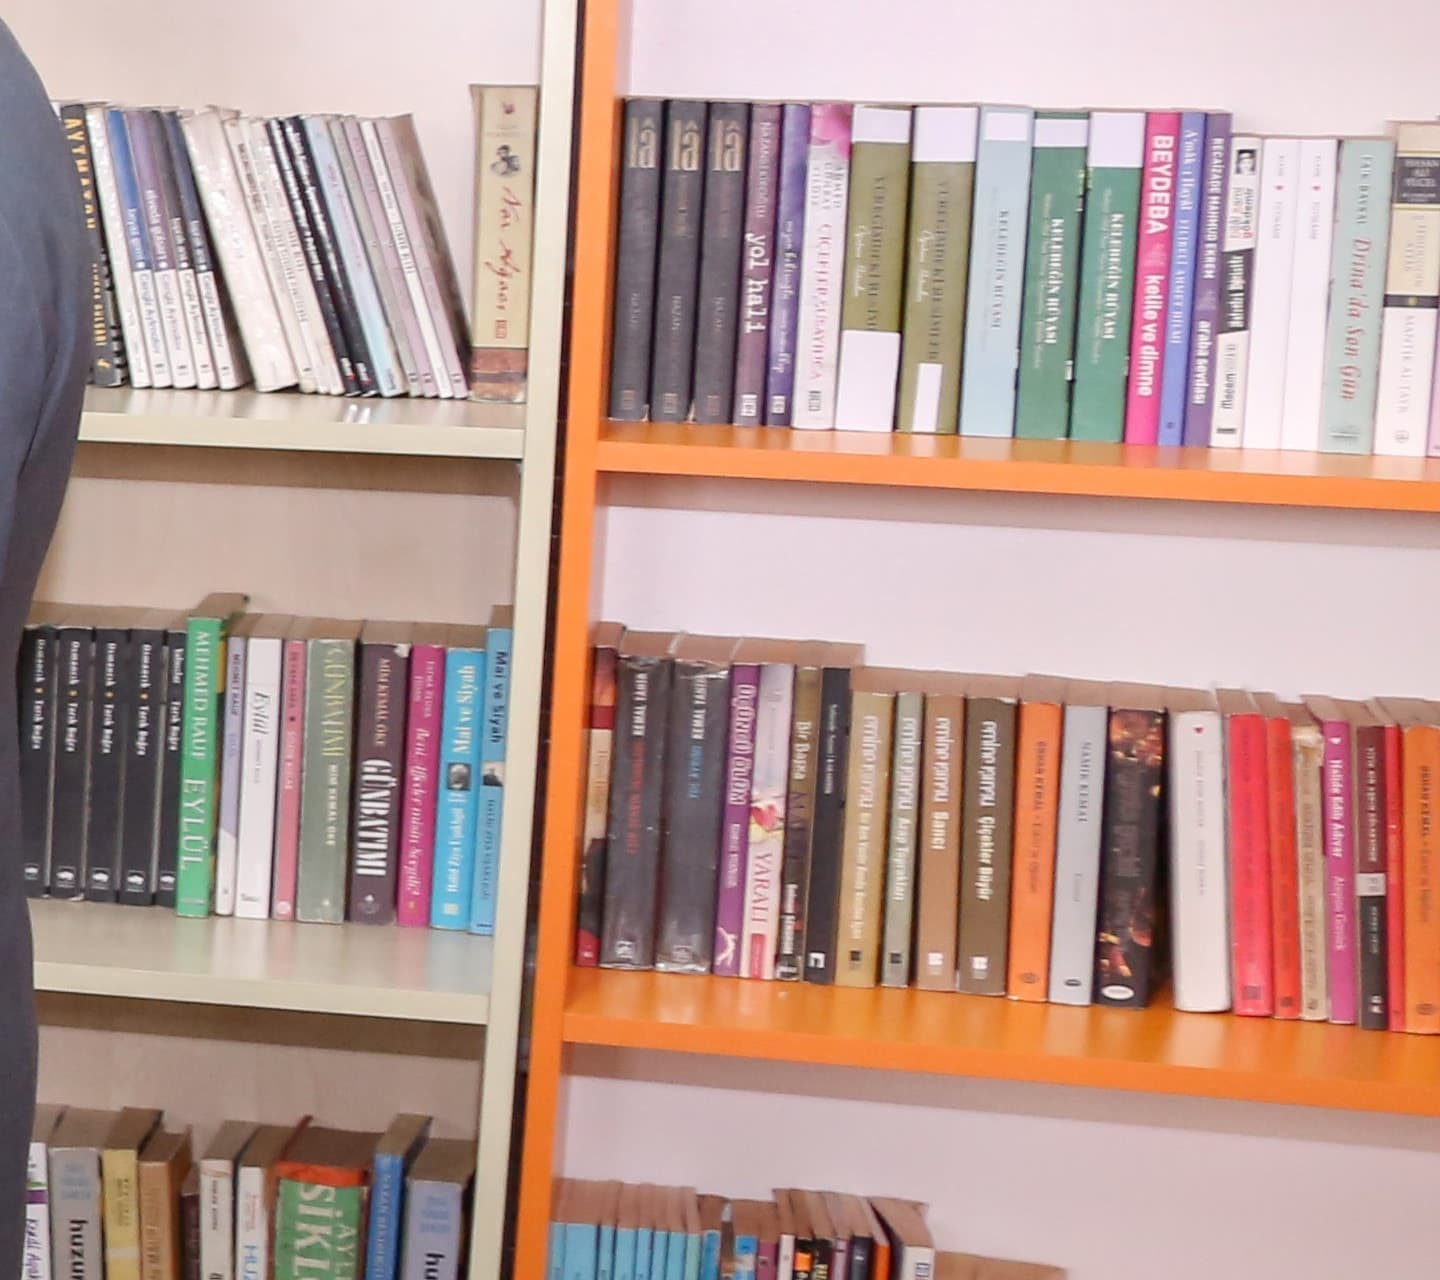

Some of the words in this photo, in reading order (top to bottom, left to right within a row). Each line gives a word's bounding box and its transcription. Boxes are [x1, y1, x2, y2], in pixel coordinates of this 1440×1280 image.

[1146, 134, 1174, 234] BEYDEBA
[745, 232, 770, 271] yol
[746, 280, 768, 333] hali
[1144, 275, 1166, 319] kelile
[1142, 324, 1160, 341] ve
[1198, 321, 1212, 357] araba
[1137, 345, 1160, 396] dimne
[192, 631, 211, 711] MEHMED
[494, 651, 508, 680] Mai
[250, 692, 269, 735] Eylül
[494, 684, 506, 700] ve
[191, 717, 208, 759] RAUF
[490, 706, 506, 743] Siyah
[180, 779, 209, 870] EYLÜL
[356, 760, 397, 876] GÜNBATIMI
